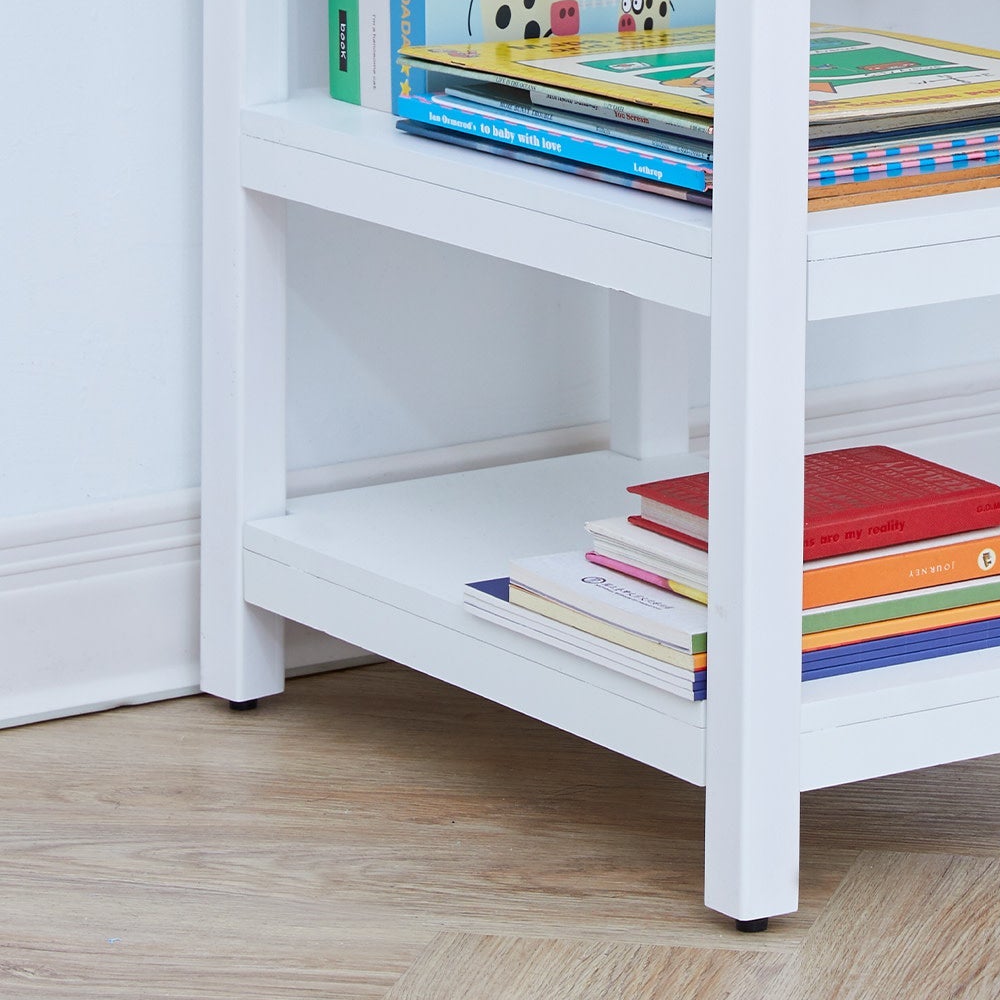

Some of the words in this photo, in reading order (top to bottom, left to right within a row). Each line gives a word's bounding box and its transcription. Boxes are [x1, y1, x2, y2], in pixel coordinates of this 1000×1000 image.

[339, 22, 347, 61] book
[480, 122, 491, 135] to
[492, 125, 515, 144] baby
[517, 132, 541, 147] with
[541, 137, 562, 152] love
[633, 161, 663, 180] Lothrop
[820, 533, 840, 545] are
[844, 528, 863, 540] my
[867, 520, 906, 536] reality
[908, 560, 956, 578] JOURNEY
